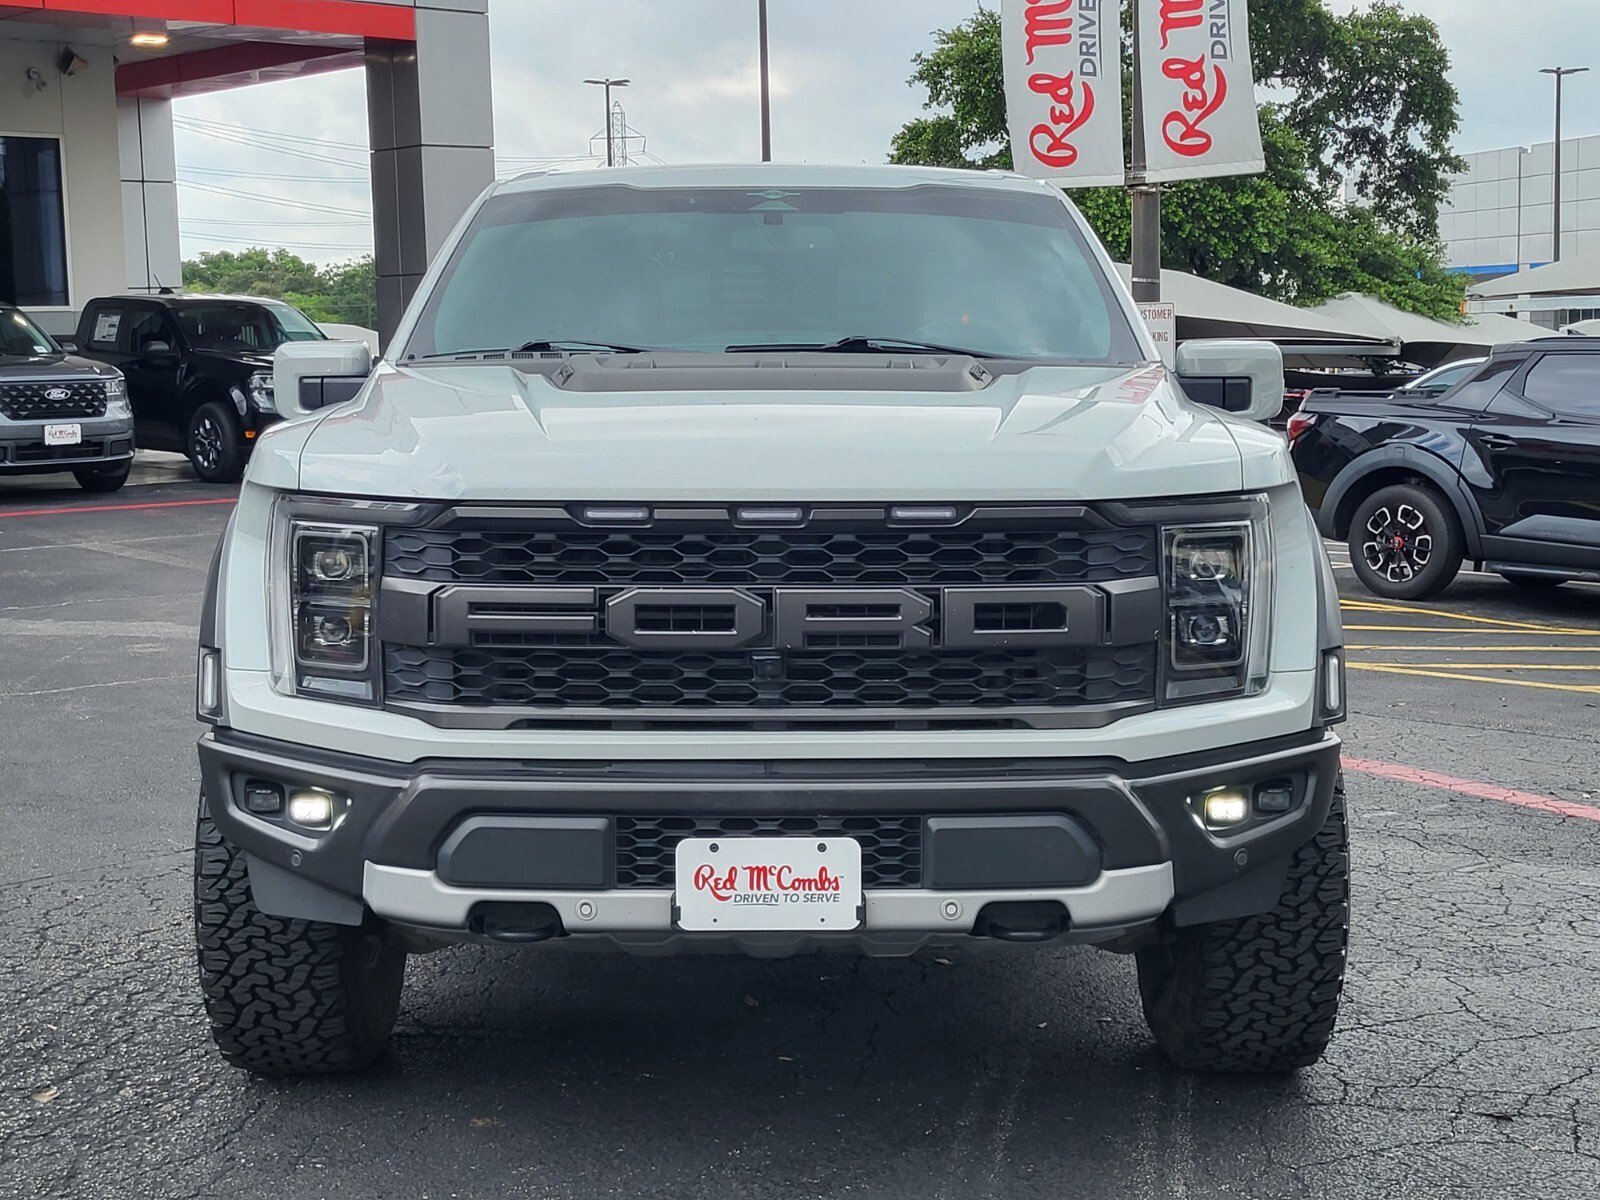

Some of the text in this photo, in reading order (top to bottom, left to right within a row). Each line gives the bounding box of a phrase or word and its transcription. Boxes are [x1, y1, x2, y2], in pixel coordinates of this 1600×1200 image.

[1027, 70, 1095, 168] Red
[1161, 53, 1228, 157] Red
[1140, 309, 1173, 320] STOMER
[1150, 331, 1169, 342] KING
[436, 586, 1100, 648] FORD
[694, 864, 840, 901] Red McCombs
[733, 893, 841, 904] DRIVEN TO SERVE
